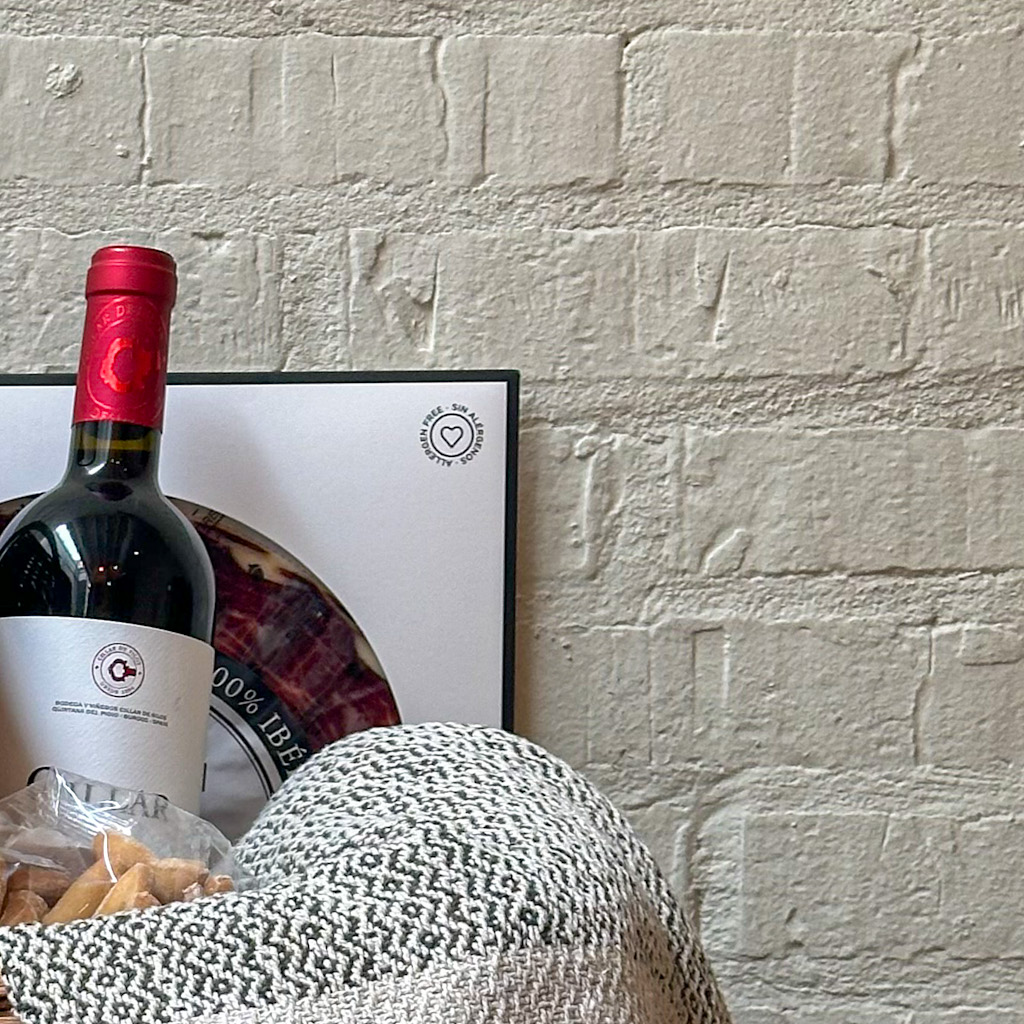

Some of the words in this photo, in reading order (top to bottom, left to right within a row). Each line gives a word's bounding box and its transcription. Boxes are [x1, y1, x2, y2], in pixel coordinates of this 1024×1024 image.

[423, 405, 445, 427] FREE
[451, 402, 469, 413] SIN
[419, 428, 453, 468] ALLERGEN
[211, 666, 264, 714] 00%
[257, 712, 308, 766] IBÉ
